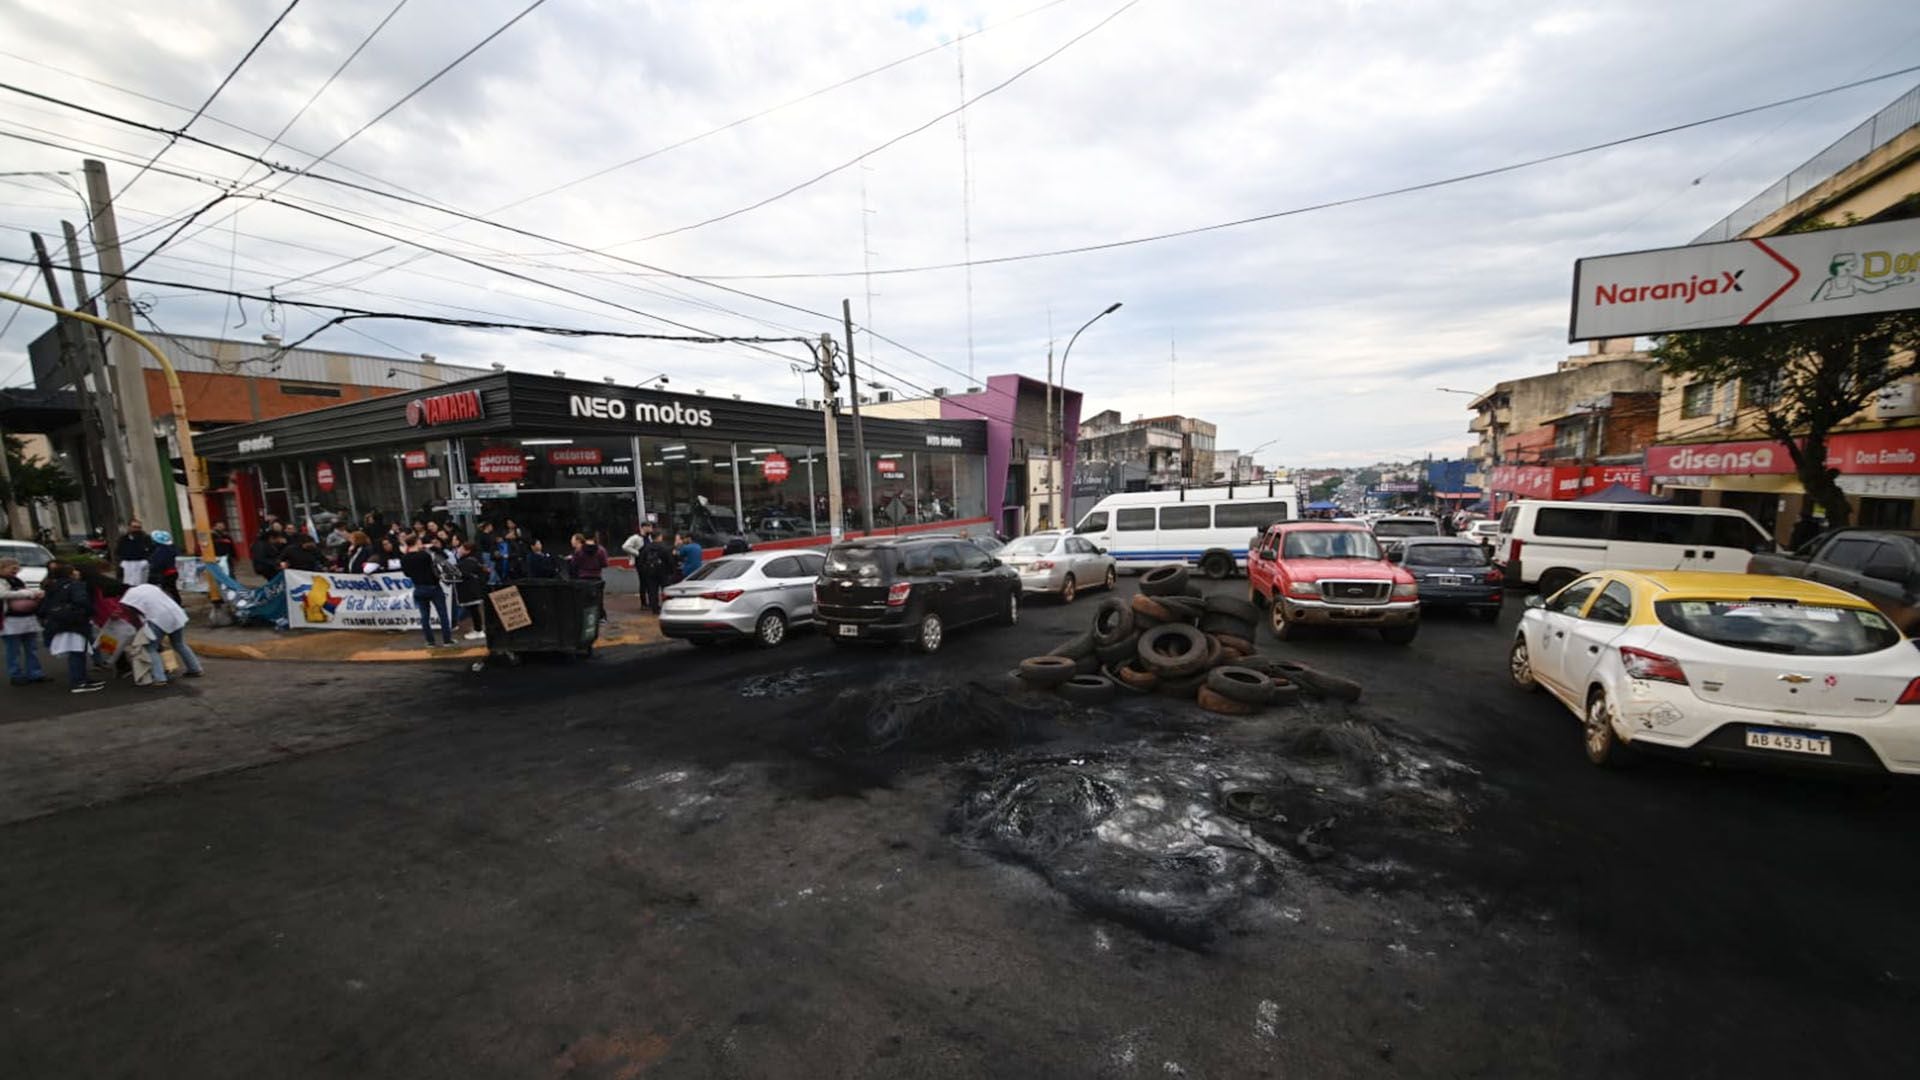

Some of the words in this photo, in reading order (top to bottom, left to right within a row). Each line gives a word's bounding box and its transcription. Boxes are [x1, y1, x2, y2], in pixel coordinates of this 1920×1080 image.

[425, 389, 481, 426] YAMAHA
[570, 395, 626, 420] NEO
[635, 401, 713, 427] motos
[1669, 447, 1774, 469] disensa
[1856, 450, 1877, 464] Don
[568, 466, 575, 475] A
[577, 466, 600, 475] SOLA
[601, 466, 629, 475] FIRMA
[1751, 734, 1770, 747] AB
[1774, 736, 1803, 750] 453
[1808, 738, 1827, 753] LT
